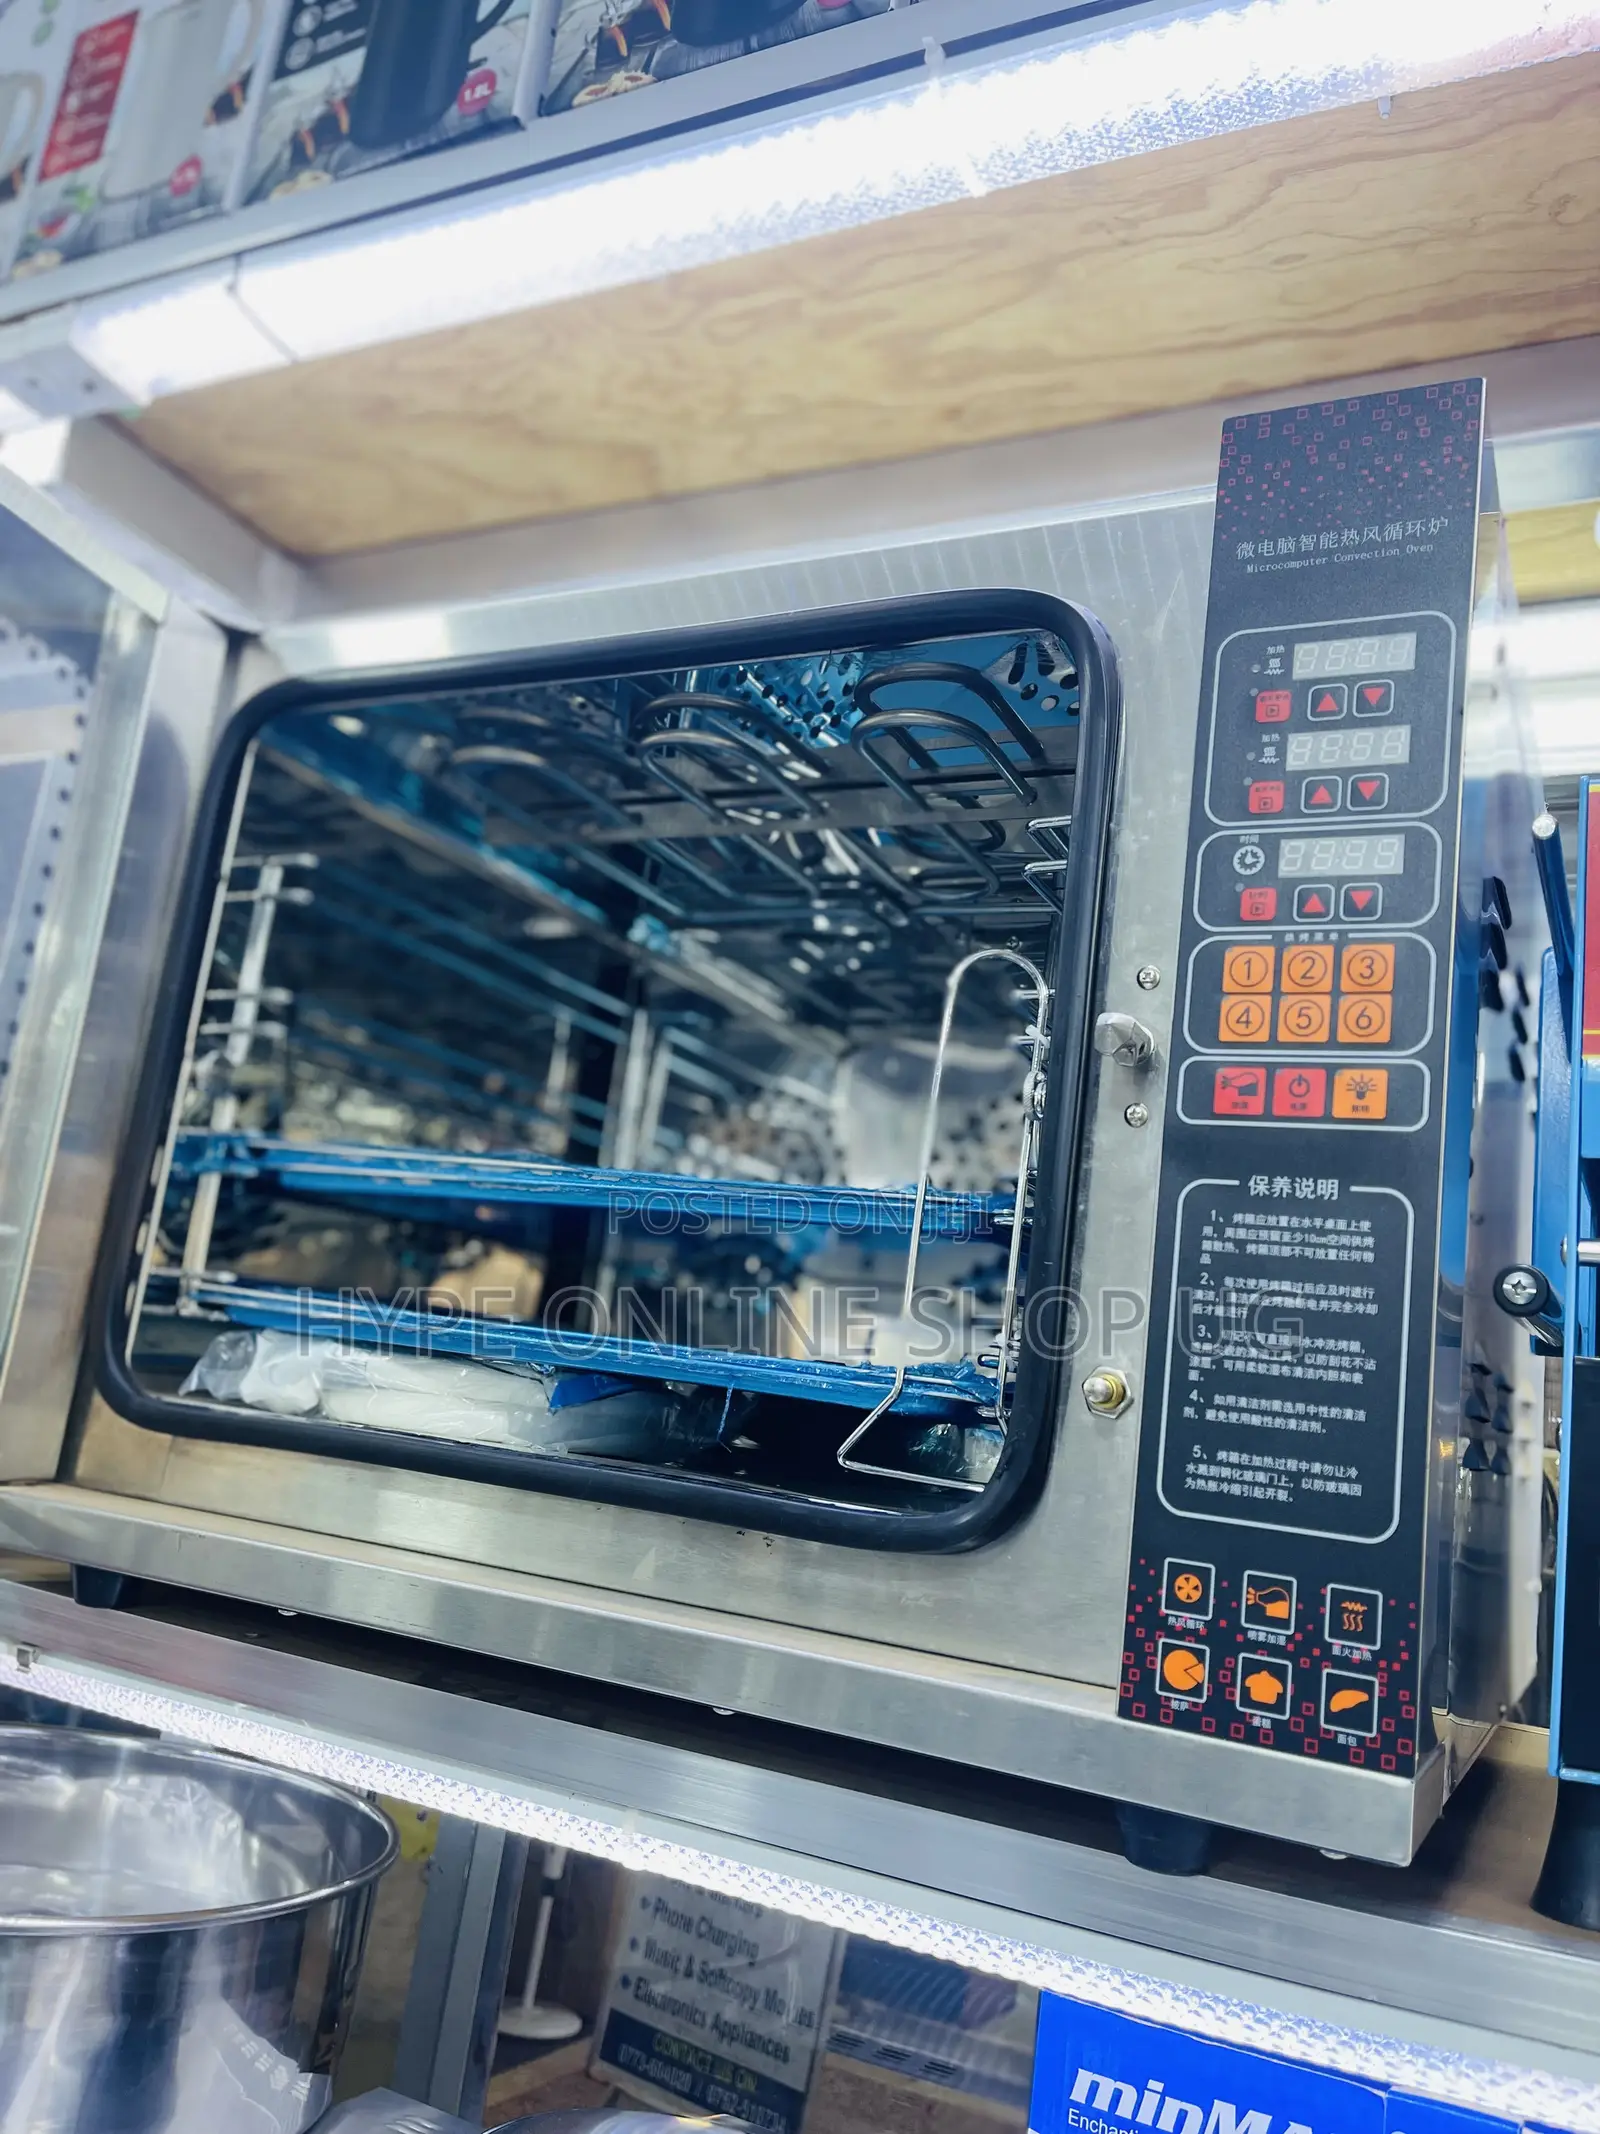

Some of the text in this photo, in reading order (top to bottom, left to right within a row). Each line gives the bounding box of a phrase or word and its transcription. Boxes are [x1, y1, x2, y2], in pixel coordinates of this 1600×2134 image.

[1235, 516, 1449, 560] 微电脑智能热风循环炉
[1247, 542, 1434, 573] Microcomputer Convection Oven
[1248, 1174, 1340, 1201] 保养说明
[1337, 1734, 1358, 1747] 面包
[653, 1897, 693, 1935] Phone
[695, 1915, 760, 1967] Charging
[644, 1936, 681, 1975] Music
[633, 1976, 790, 2065] Electronics Appliances
